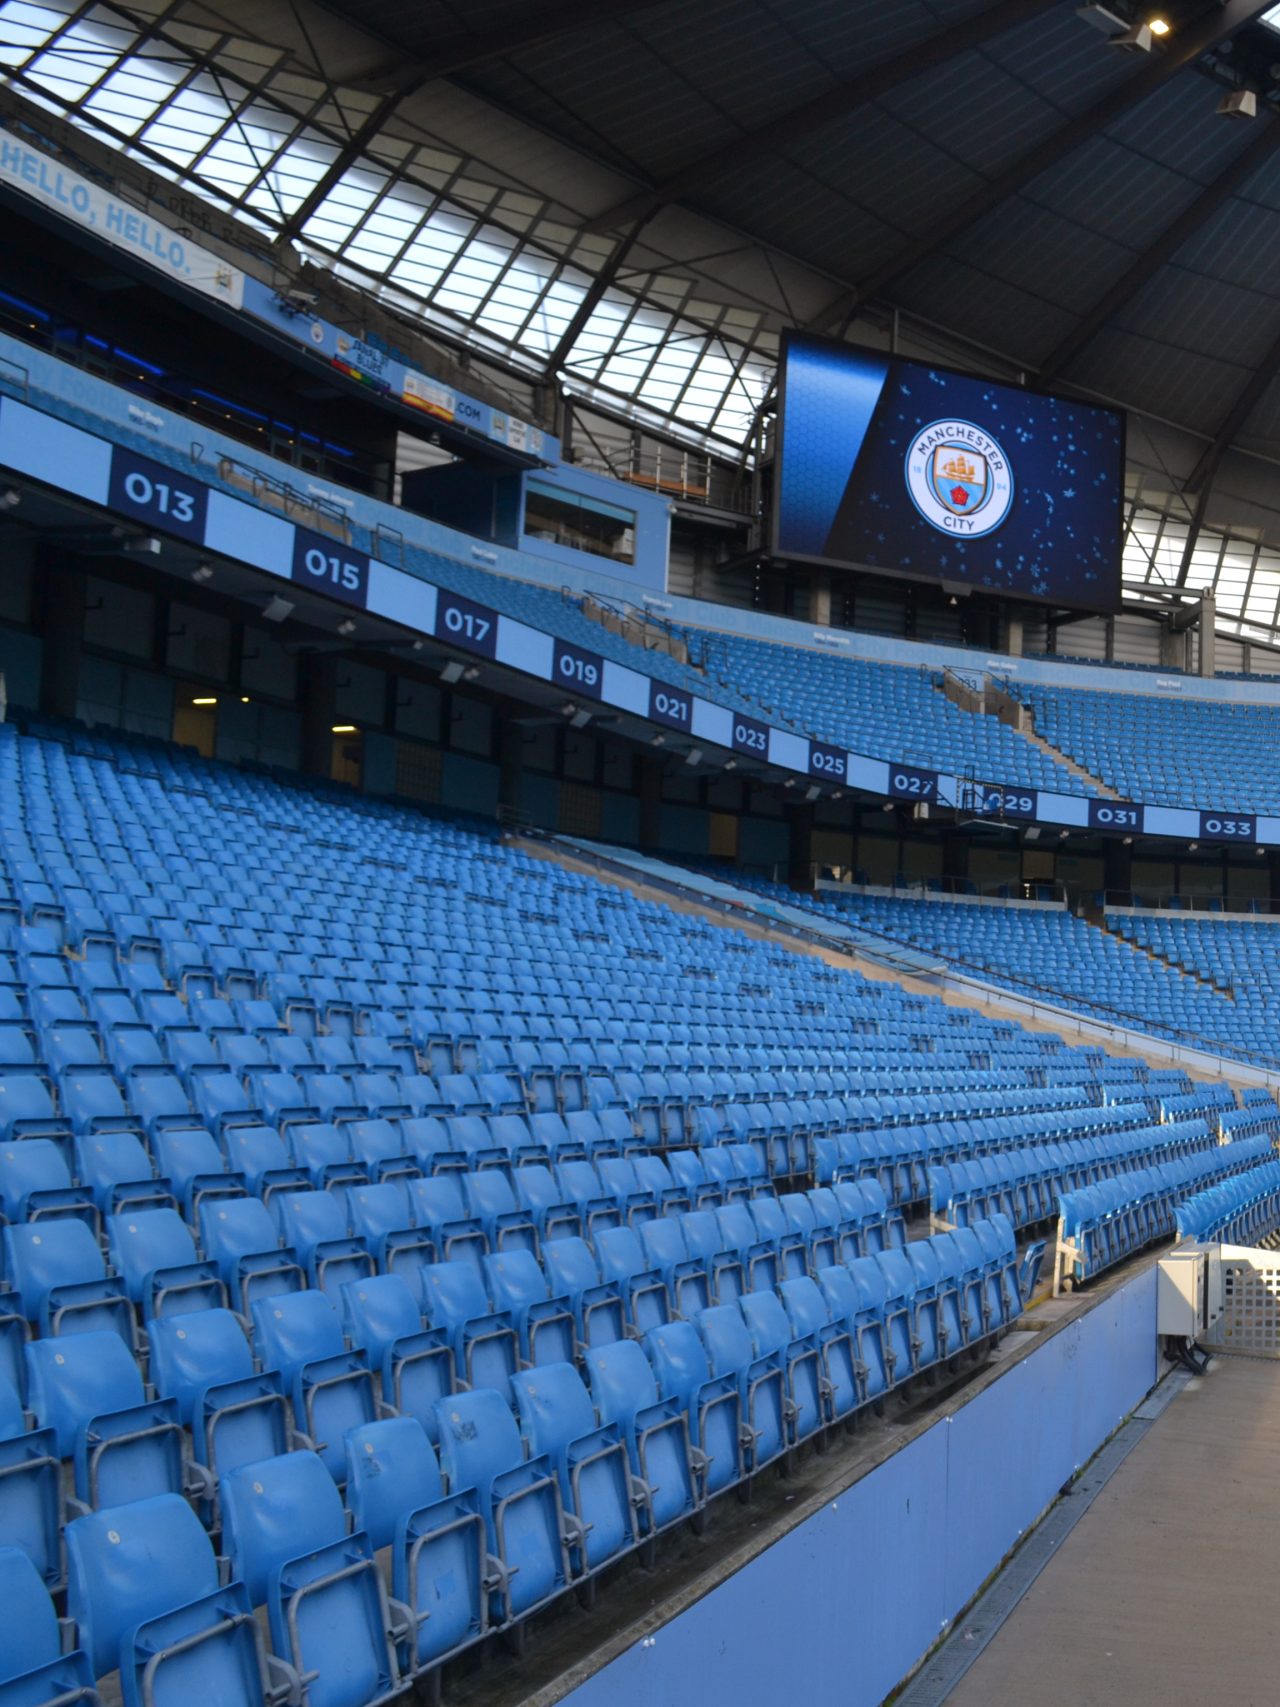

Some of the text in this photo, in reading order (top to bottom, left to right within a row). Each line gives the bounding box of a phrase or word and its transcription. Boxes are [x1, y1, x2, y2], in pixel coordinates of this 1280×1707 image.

[1, 139, 193, 274] HELLO, HELLO.
[917, 425, 1004, 473] MANCHESTER
[943, 515, 975, 532] CITY
